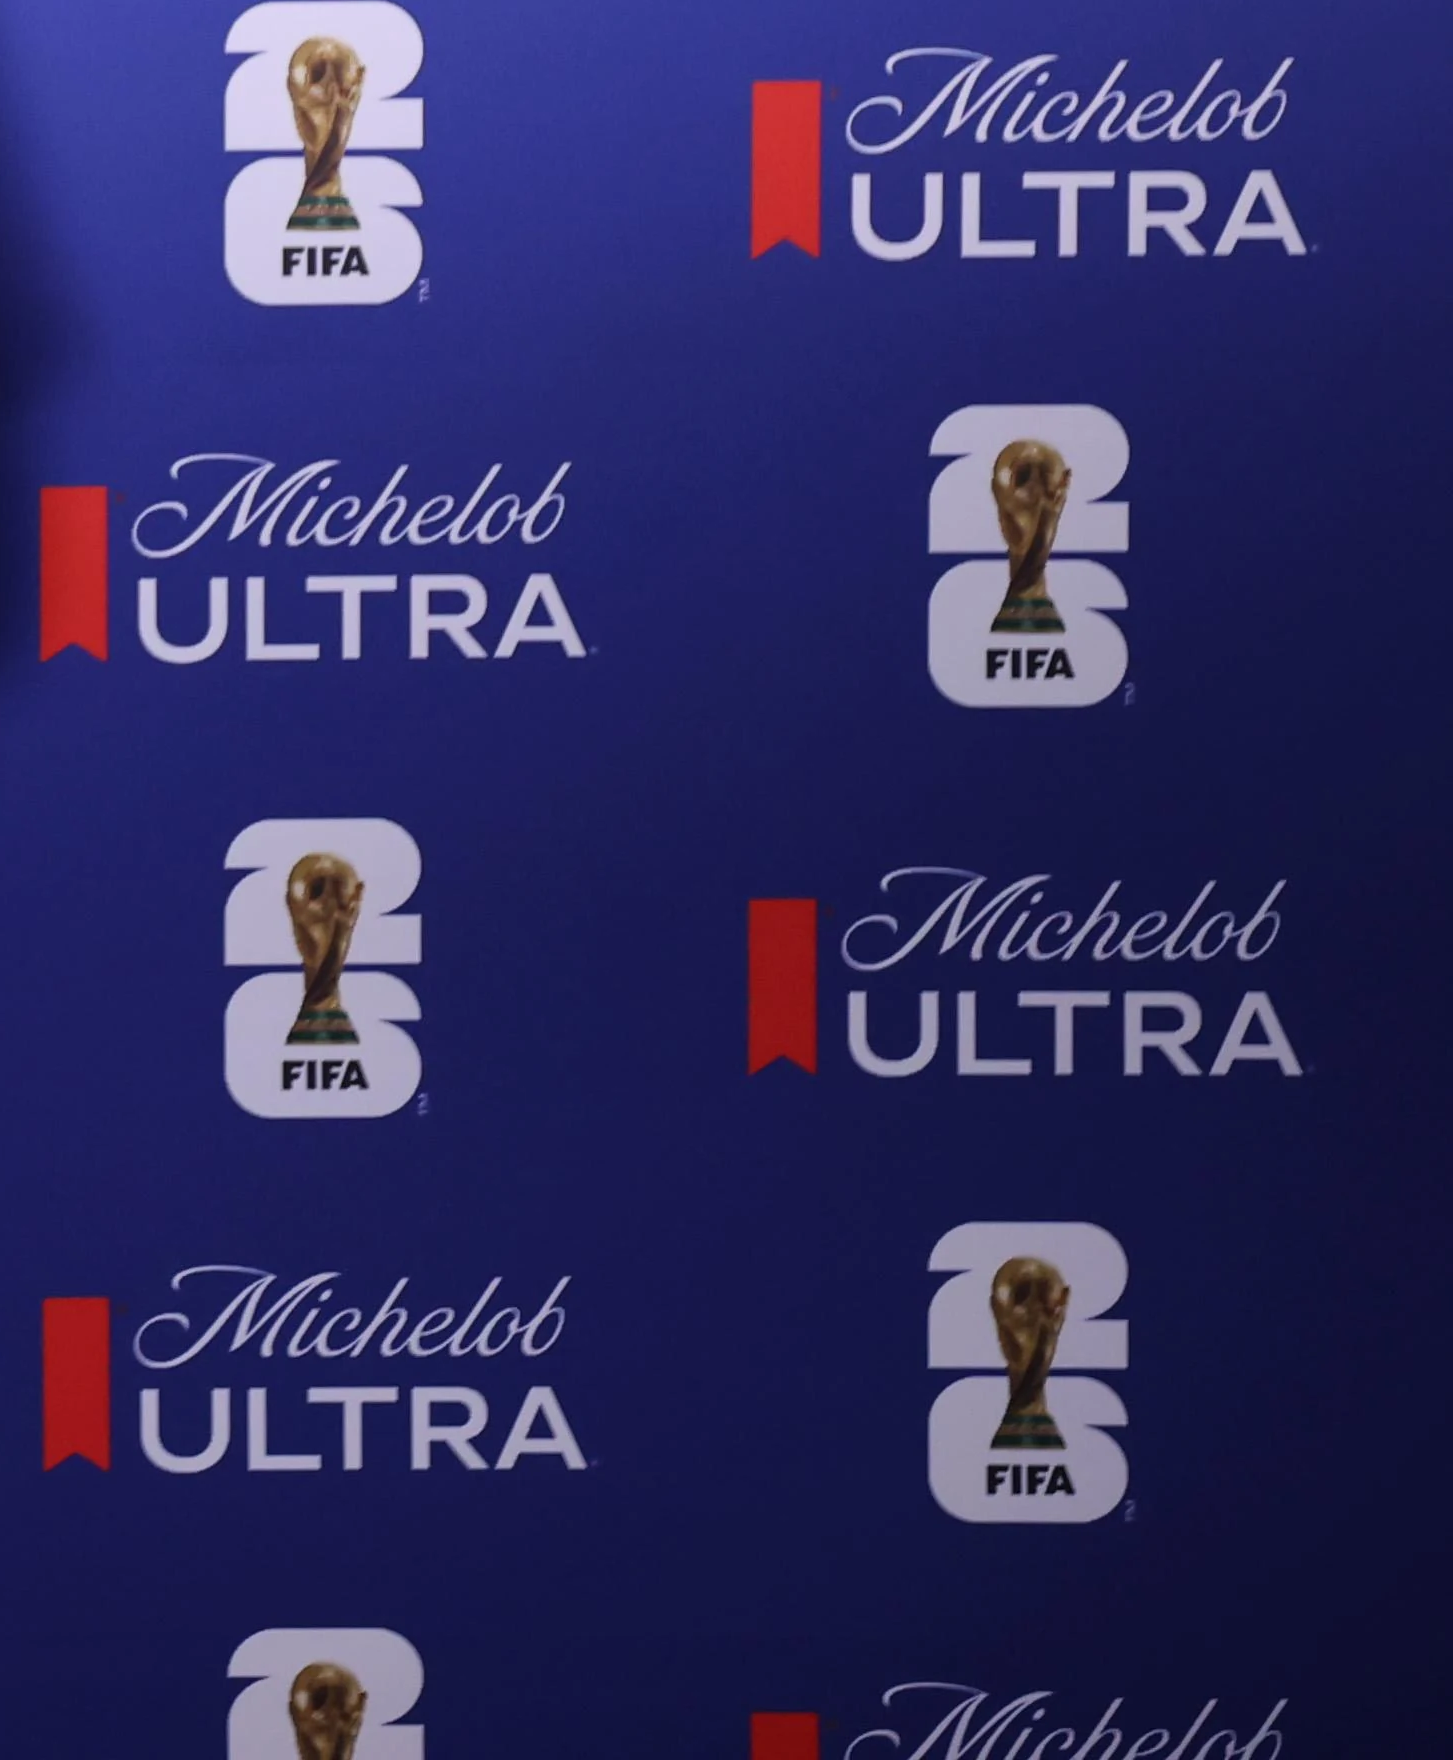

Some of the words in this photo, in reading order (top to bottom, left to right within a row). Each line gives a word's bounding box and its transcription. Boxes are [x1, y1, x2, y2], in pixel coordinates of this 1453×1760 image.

[846, 48, 1293, 154] Michelob
[852, 170, 1306, 260] ULTRA
[282, 246, 369, 277] FIFA
[133, 454, 571, 558] Michelob
[138, 574, 586, 664] ULTRA
[986, 648, 1075, 679] FIFA
[843, 868, 1286, 970] Michelob
[282, 1059, 369, 1091] FIFA
[848, 991, 1302, 1077] ULTRA
[136, 1266, 570, 1368] Michelob
[141, 1387, 586, 1473] ULTRA
[986, 1464, 1075, 1496] FIFA
